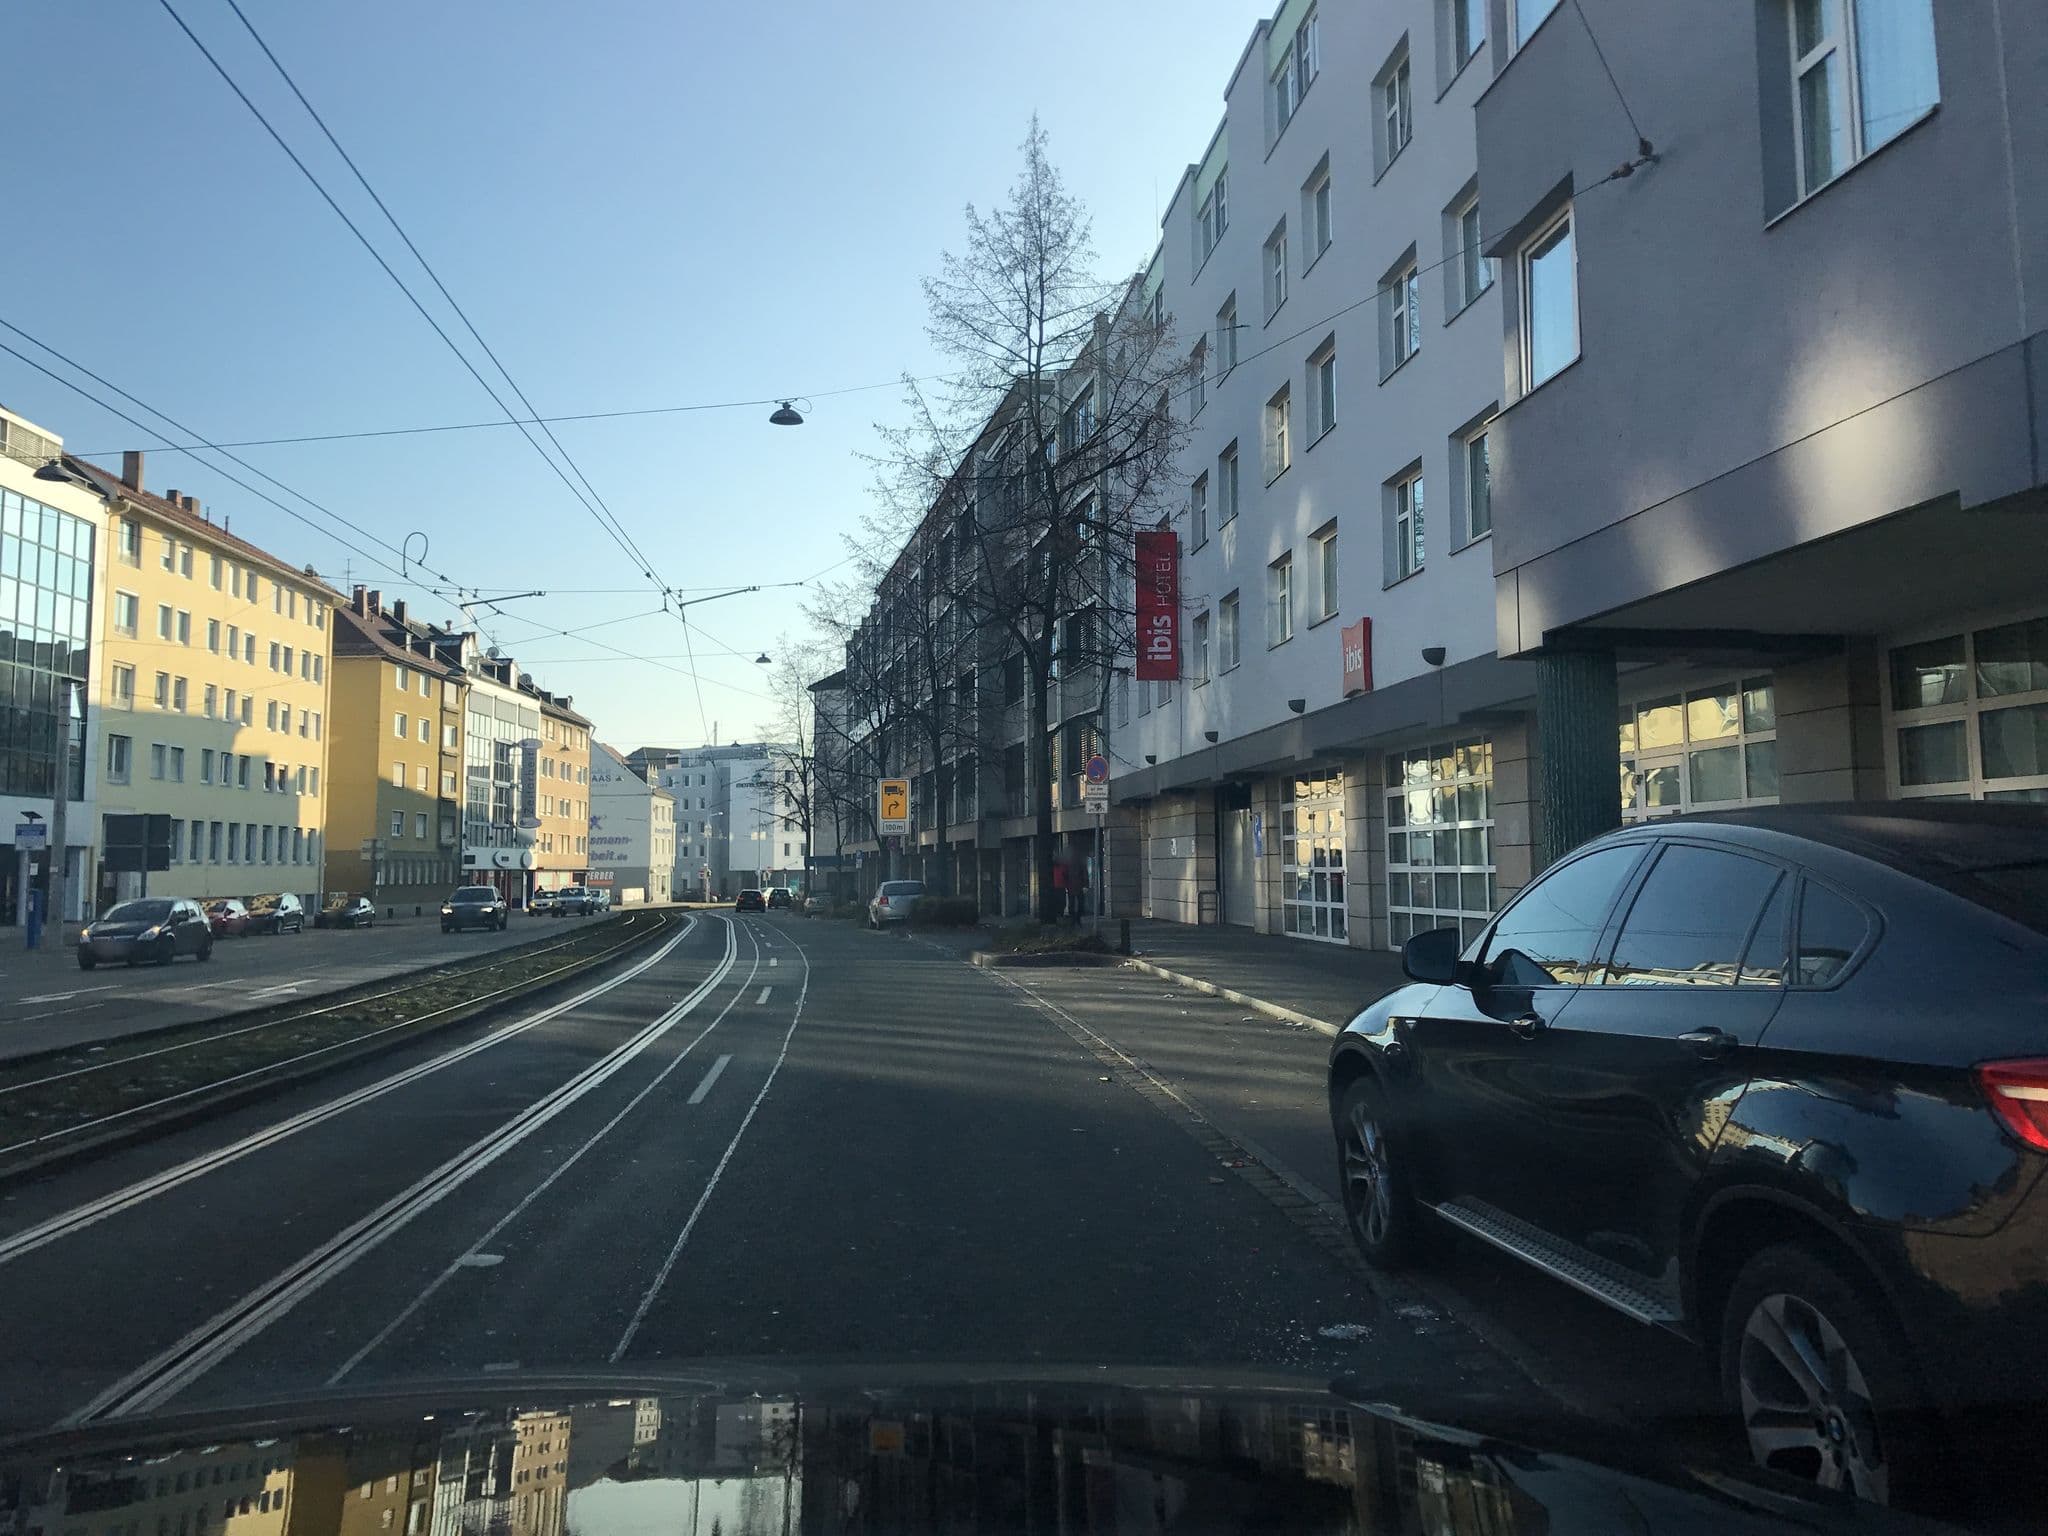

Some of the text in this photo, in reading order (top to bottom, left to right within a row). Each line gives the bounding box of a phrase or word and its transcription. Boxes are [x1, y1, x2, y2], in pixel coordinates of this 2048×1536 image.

[1147, 551, 1172, 661] ibis HOTEL
[1346, 643, 1362, 673] ibis
[591, 774, 611, 782] AAS
[590, 850, 628, 861] beit.de
